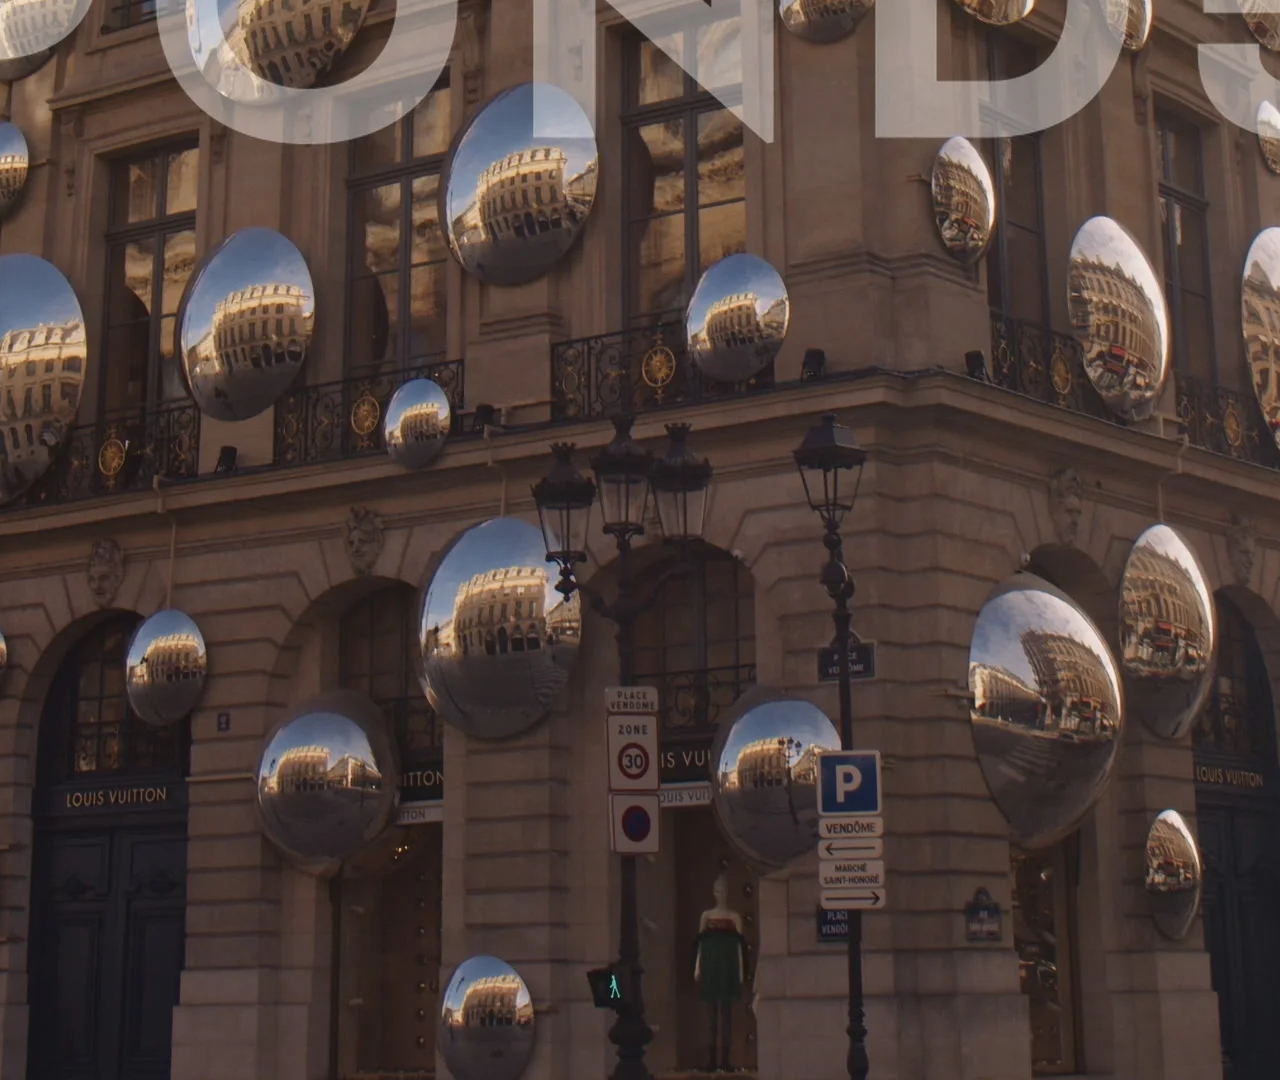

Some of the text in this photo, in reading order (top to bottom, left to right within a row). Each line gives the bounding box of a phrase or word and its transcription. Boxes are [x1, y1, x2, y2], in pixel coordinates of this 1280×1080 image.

[617, 691, 648, 700] PLACE
[618, 725, 648, 735] ZONE
[624, 754, 644, 769] 30
[1196, 765, 1264, 788] LOUIS VUITTON
[835, 764, 863, 803] P
[66, 787, 168, 808] LOUIS VUITTON
[826, 821, 876, 834] VENDÔME
[835, 863, 868, 873] MARCHÉ
[824, 875, 880, 885] SAINT-HONORÉ
